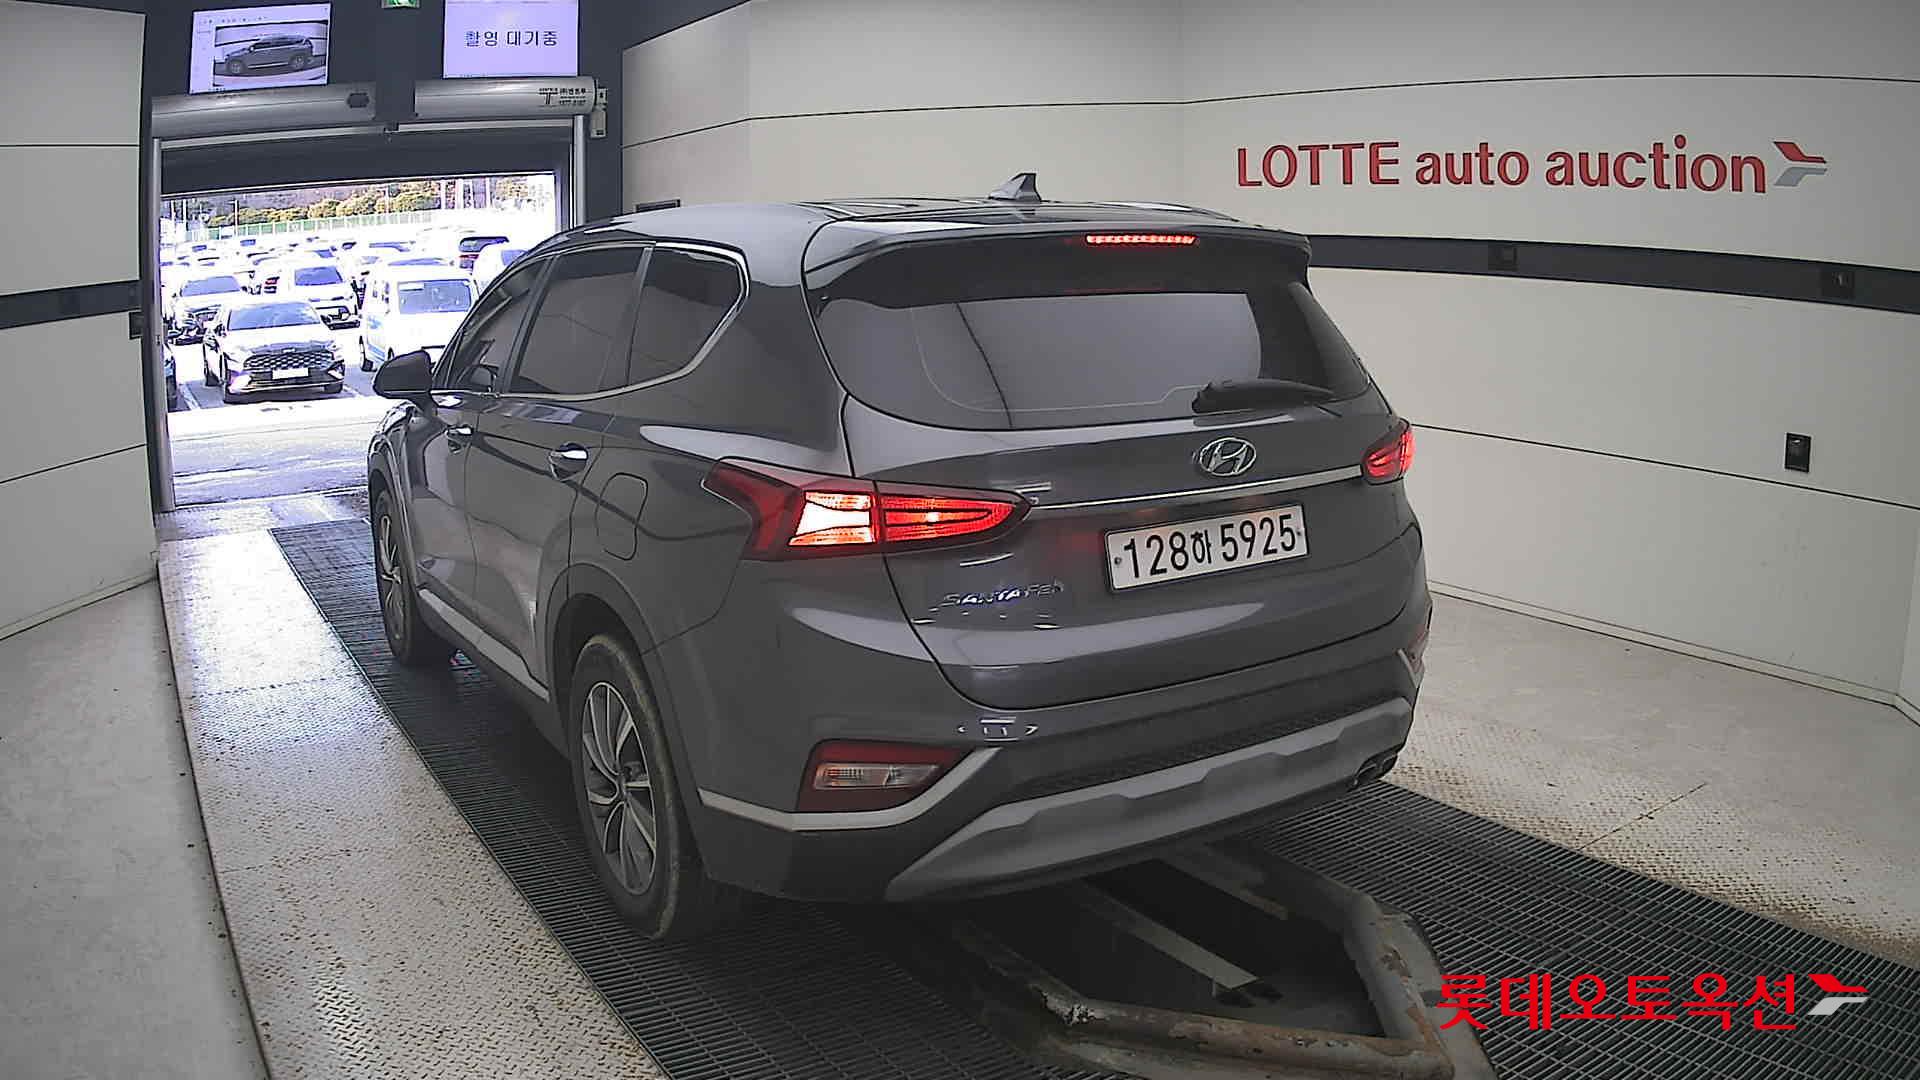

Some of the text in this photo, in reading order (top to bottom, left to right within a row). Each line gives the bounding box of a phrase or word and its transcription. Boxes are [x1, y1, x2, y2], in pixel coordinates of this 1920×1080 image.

[506, 31, 557, 46] 대기중
[1237, 134, 1766, 194] LOTTE auto auction
[1220, 513, 1296, 562] 5925
